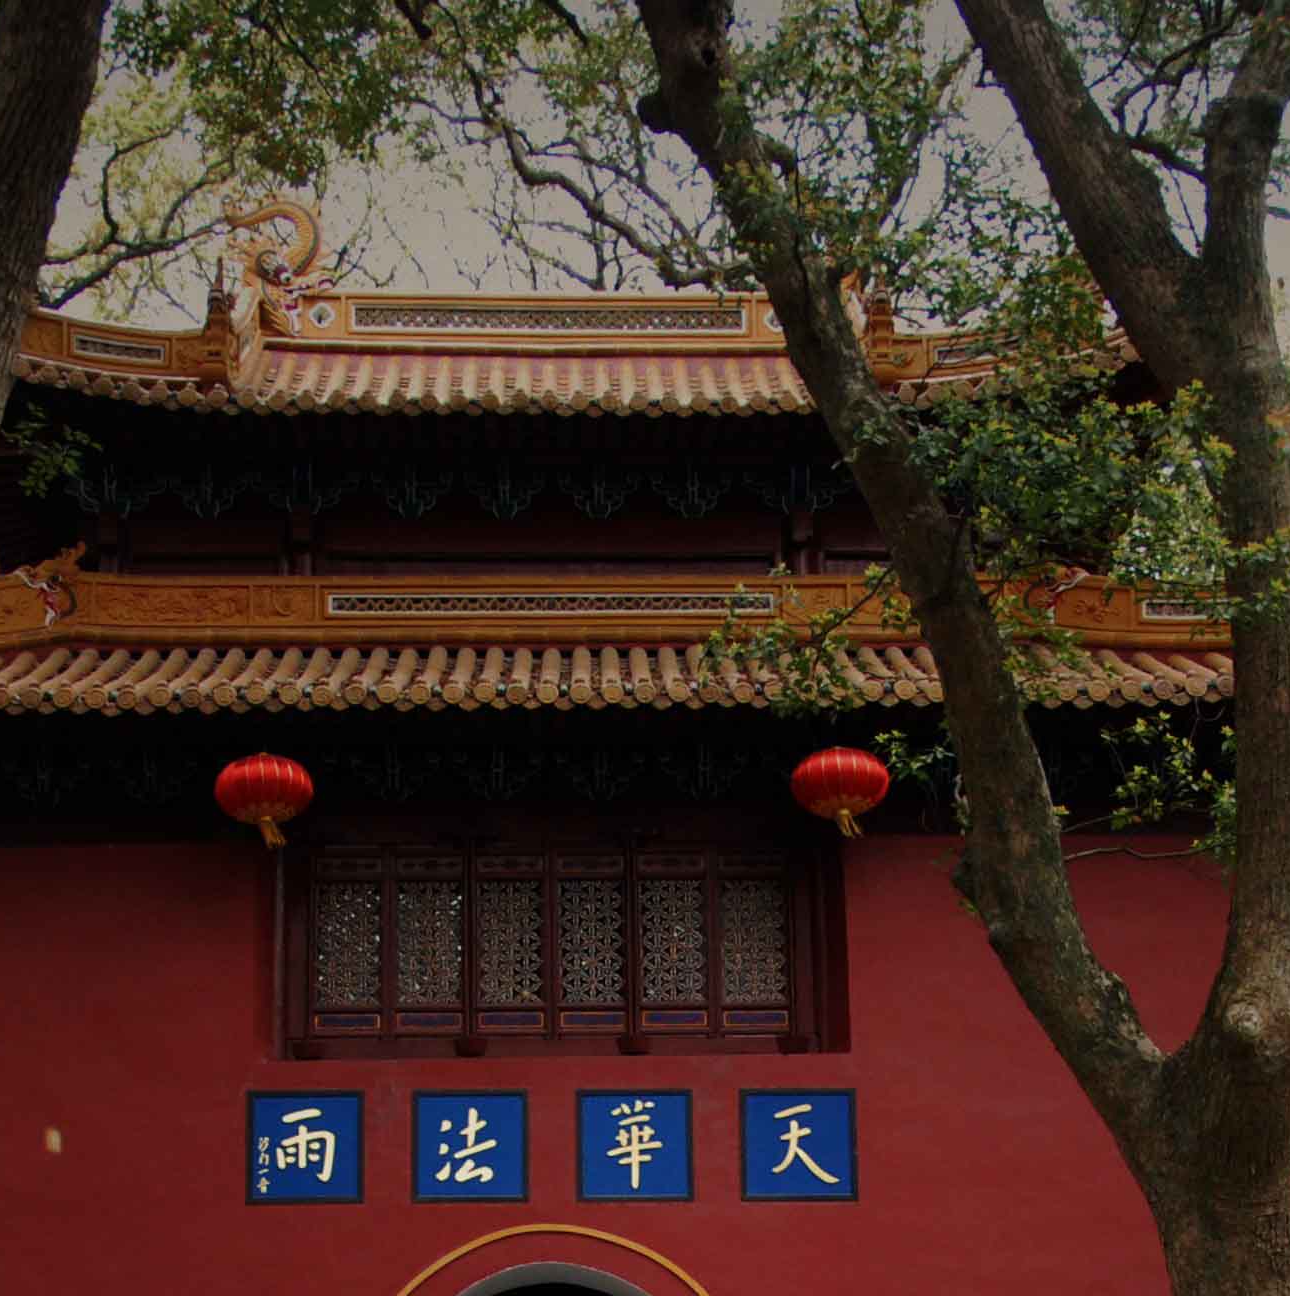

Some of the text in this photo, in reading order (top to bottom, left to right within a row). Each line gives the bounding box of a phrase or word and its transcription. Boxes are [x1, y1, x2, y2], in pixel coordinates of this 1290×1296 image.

[275, 1099, 841, 1190] 天 華 法 雨
